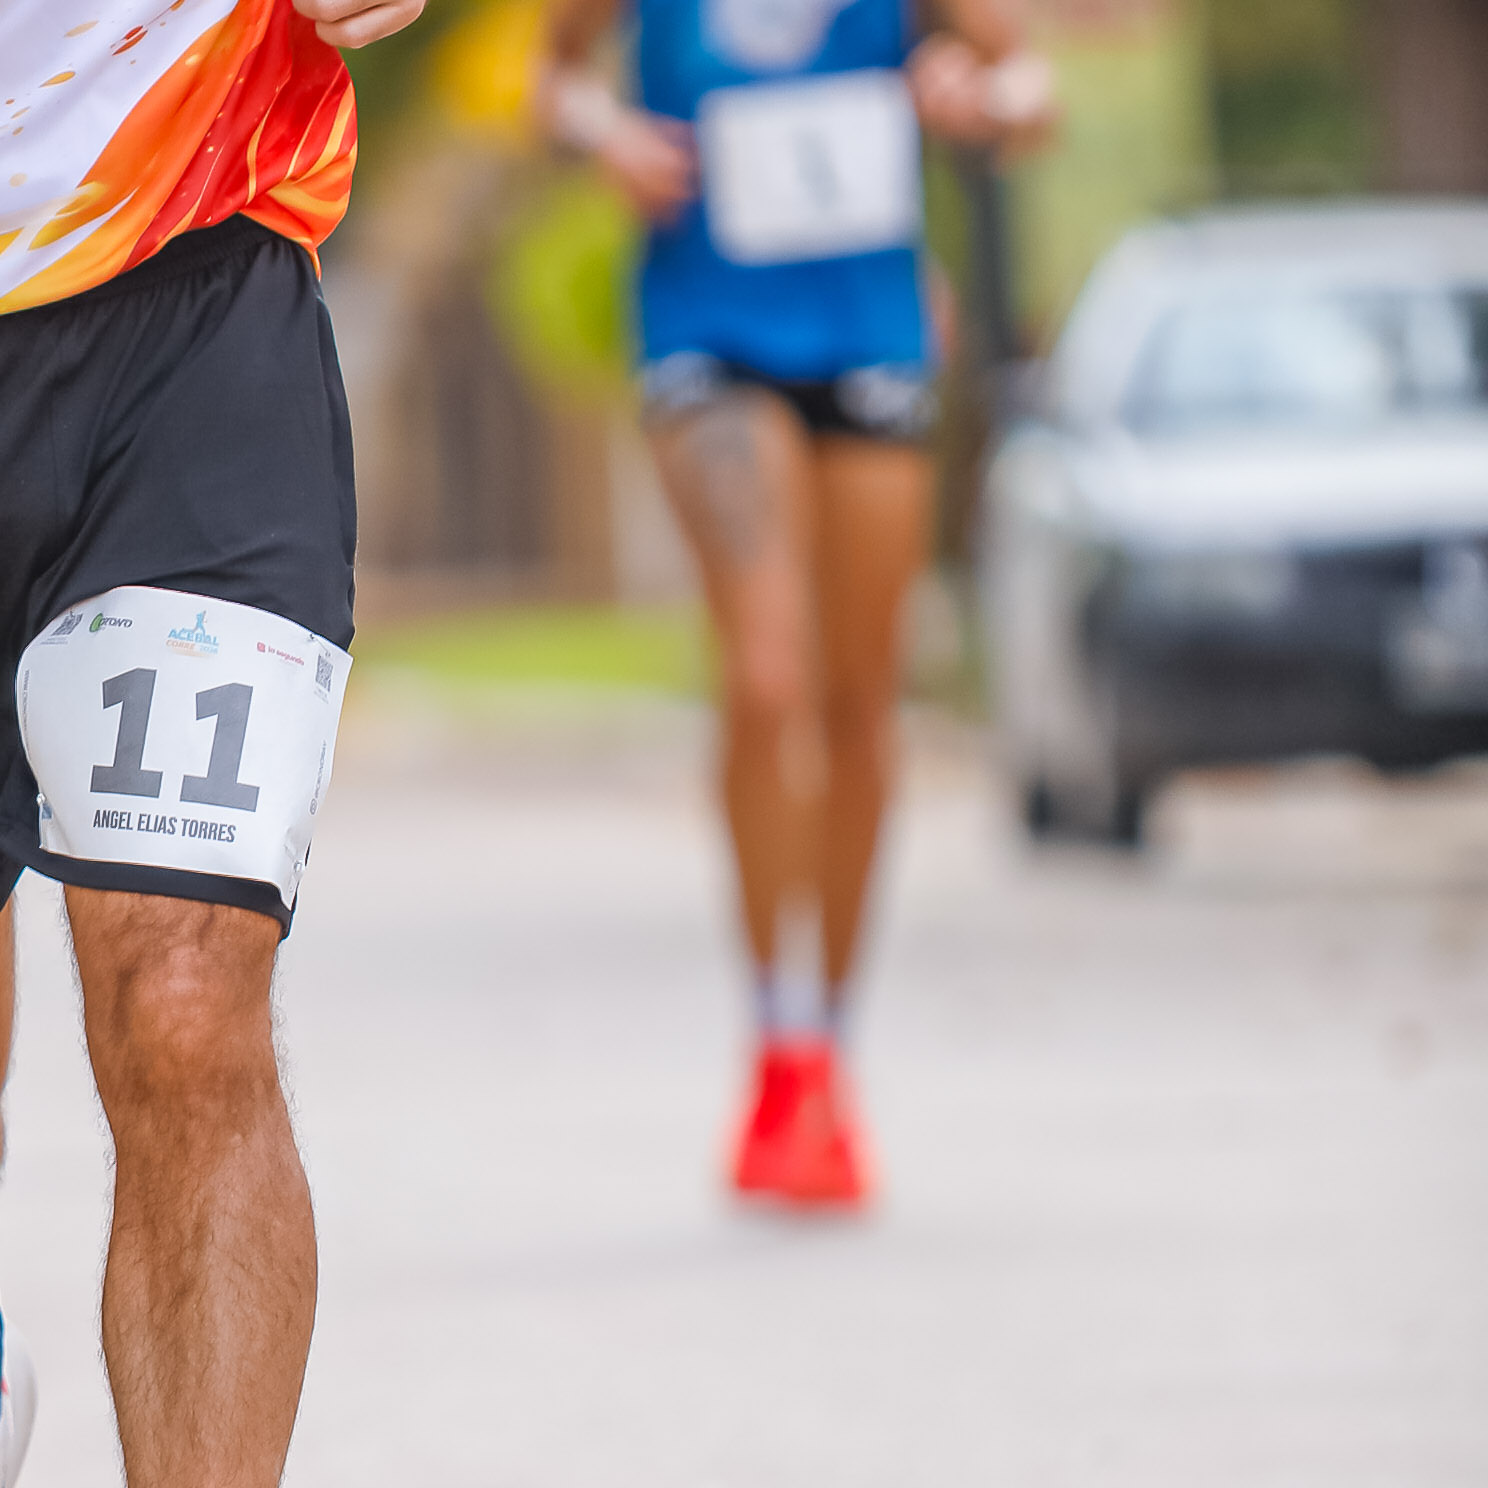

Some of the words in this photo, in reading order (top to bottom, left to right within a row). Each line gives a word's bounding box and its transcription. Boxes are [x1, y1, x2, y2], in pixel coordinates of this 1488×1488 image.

[167, 628, 219, 647] ACEBAL
[90, 667, 260, 812] 11
[92, 809, 134, 831] ANGEL
[137, 812, 178, 836] ELIAS
[181, 817, 237, 843] TORRES
